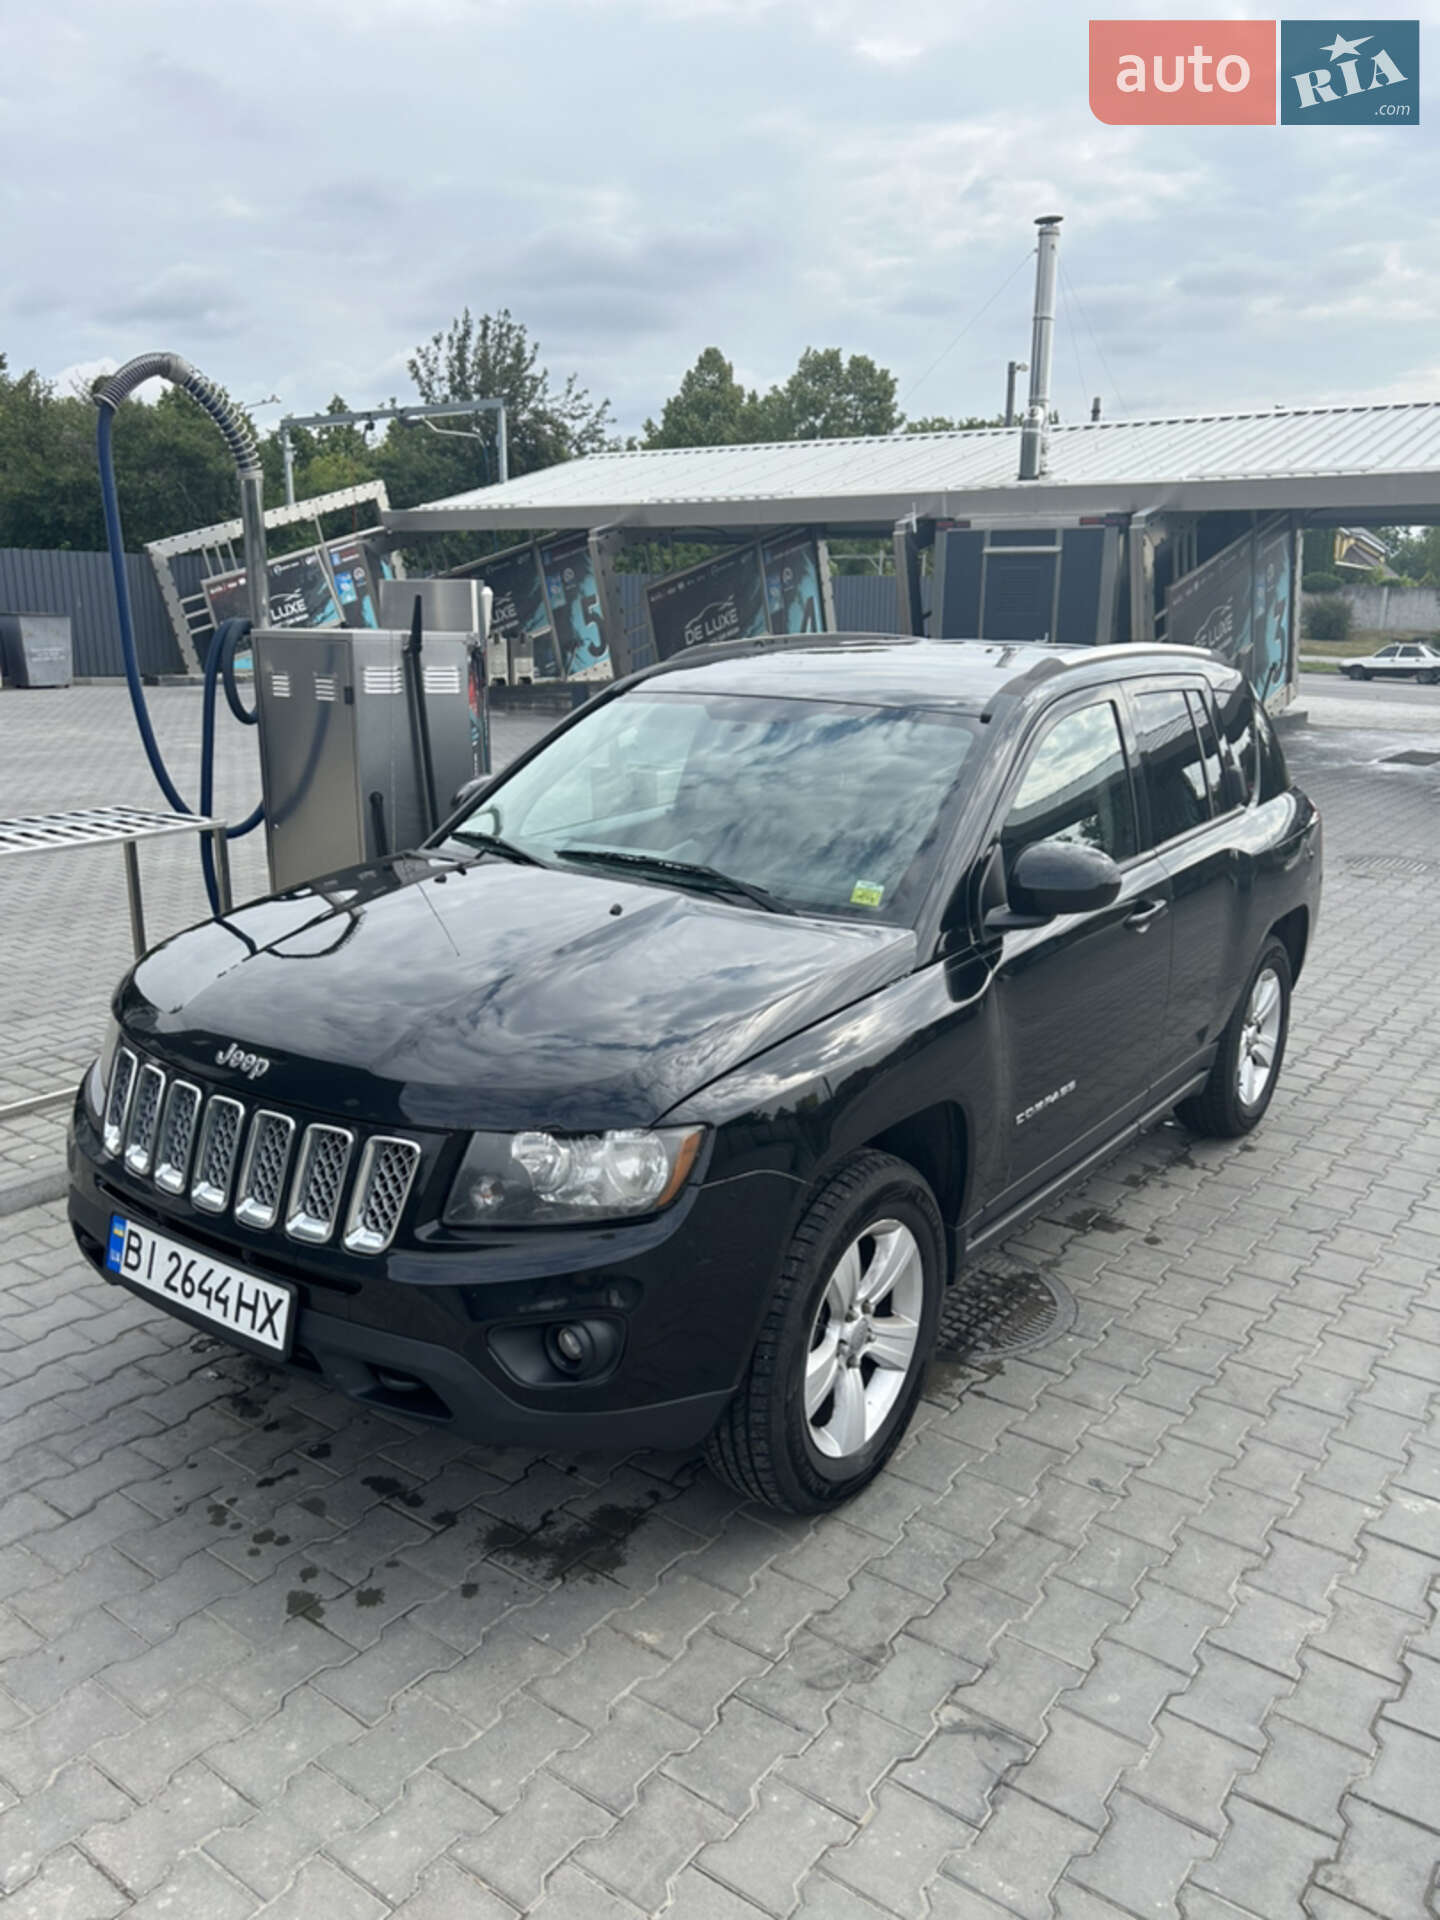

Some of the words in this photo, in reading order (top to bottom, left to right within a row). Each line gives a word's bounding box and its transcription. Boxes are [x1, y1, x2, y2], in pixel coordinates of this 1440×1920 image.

[270, 598, 308, 621] LUXE
[684, 624, 704, 646] DE
[704, 607, 739, 636] LUXE
[215, 1042, 270, 1080] Jeep
[123, 1229, 157, 1281] BI
[163, 1250, 232, 1319] 2644
[234, 1281, 284, 1342] HX
